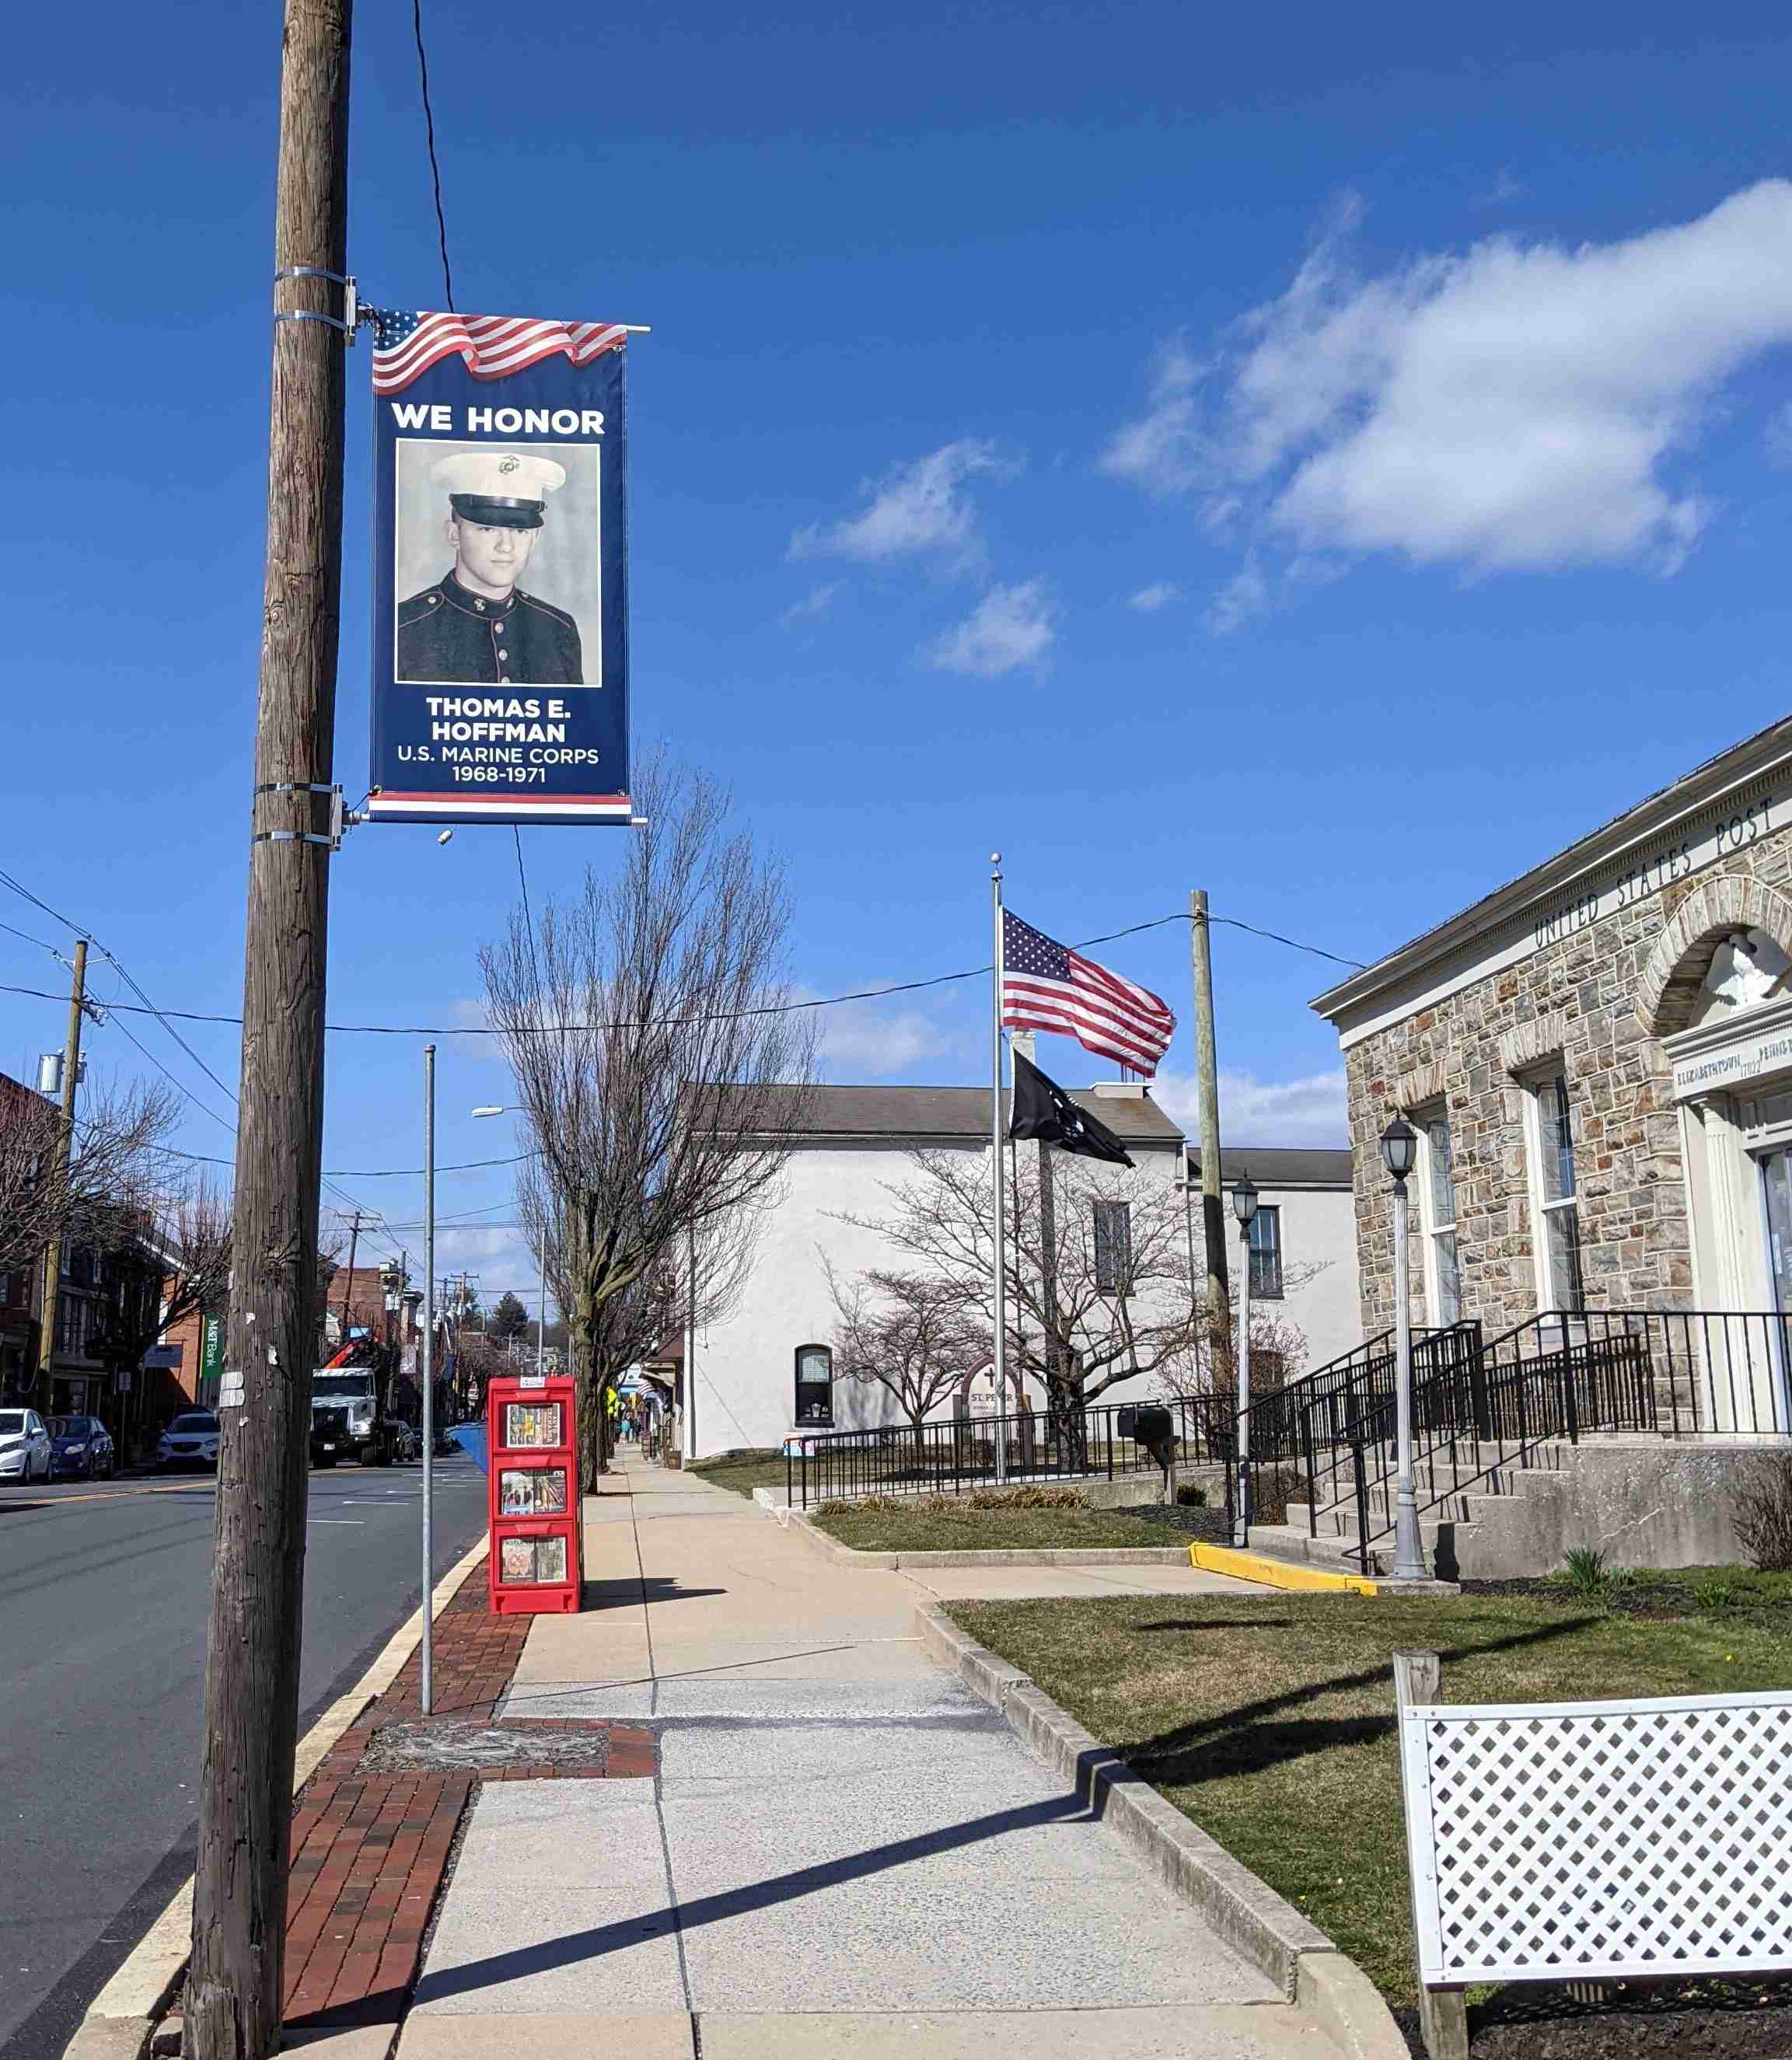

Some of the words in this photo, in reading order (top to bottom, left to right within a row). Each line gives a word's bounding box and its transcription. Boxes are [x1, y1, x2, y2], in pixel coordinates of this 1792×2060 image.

[391, 403, 452, 431] WE
[467, 407, 606, 435] HONOR
[426, 697, 540, 718] THOMAS
[548, 700, 571, 718] E.
[432, 722, 565, 742] HOFFMAN
[398, 746, 435, 762] U.S.
[442, 747, 523, 763] MARINE
[529, 749, 599, 764] CORPS
[452, 766, 546, 784] 1968-1971
[1535, 894, 1598, 948] UNITED
[1616, 843, 1692, 906] STATES
[1716, 796, 1773, 855] POST
[208, 1319, 218, 1343] M&T
[206, 1343, 217, 1367] Bank
